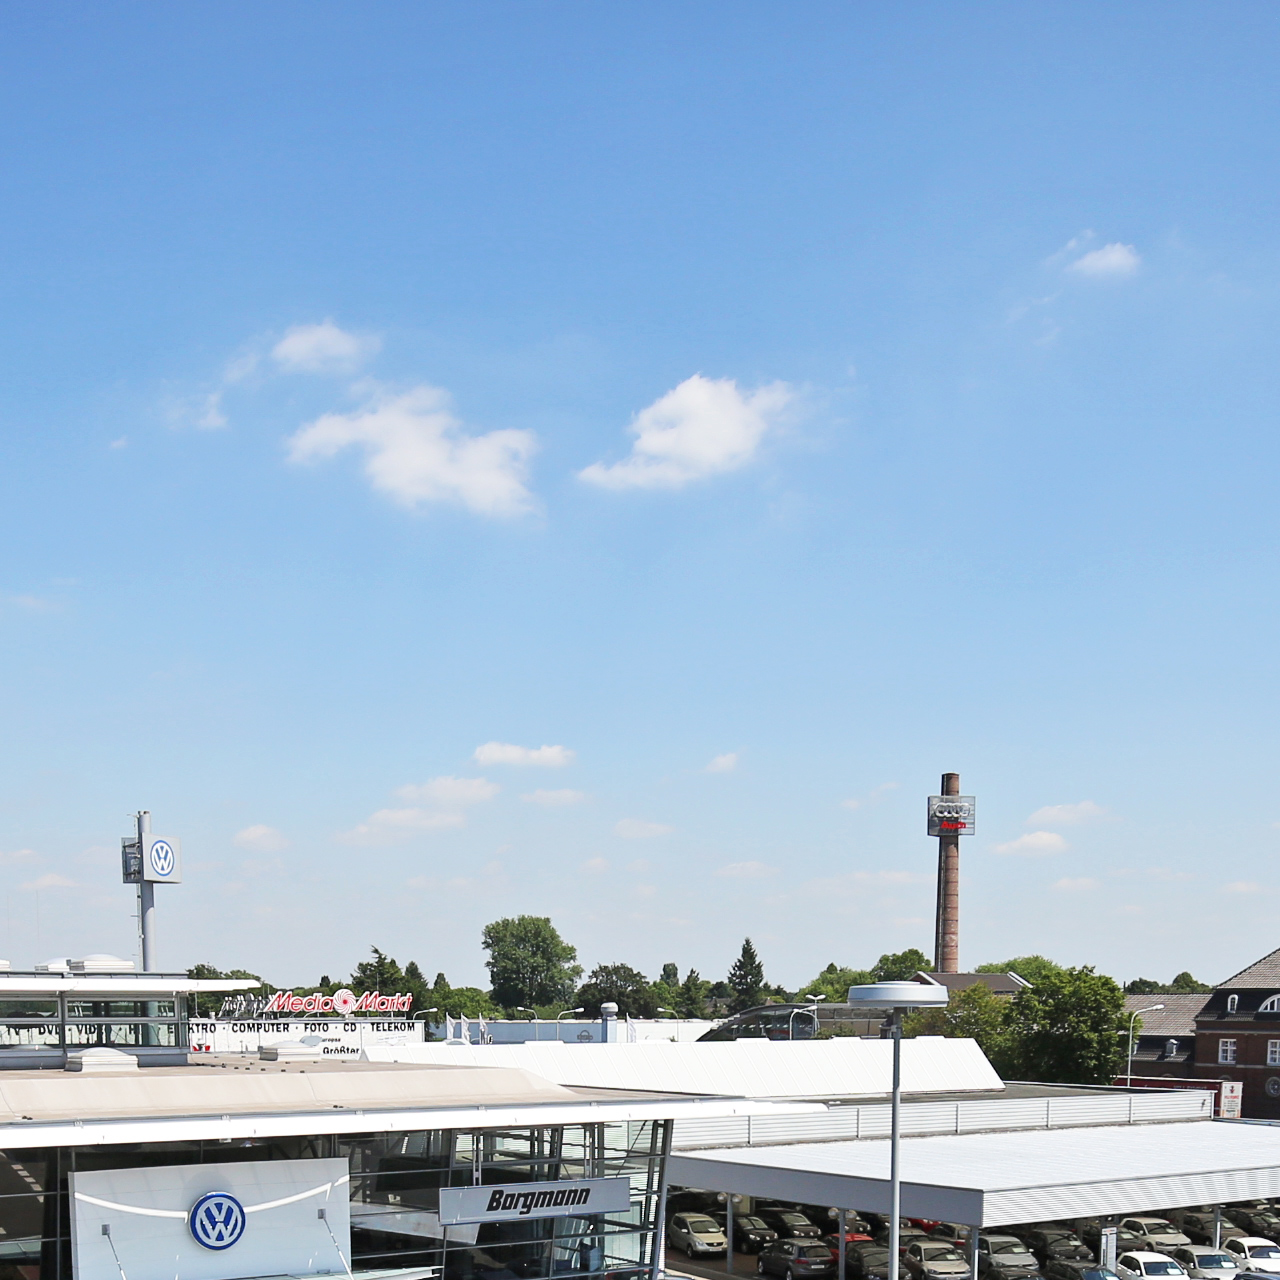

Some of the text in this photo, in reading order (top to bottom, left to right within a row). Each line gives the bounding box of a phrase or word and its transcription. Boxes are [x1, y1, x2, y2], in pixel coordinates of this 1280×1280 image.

[940, 821, 967, 829] Audi
[264, 991, 334, 1012] Media
[354, 991, 413, 1012] Markt
[231, 1023, 289, 1034] COMPUTER
[304, 1023, 329, 1033] FOTO
[343, 1023, 357, 1033] CD
[370, 1022, 415, 1032] TELEKOM
